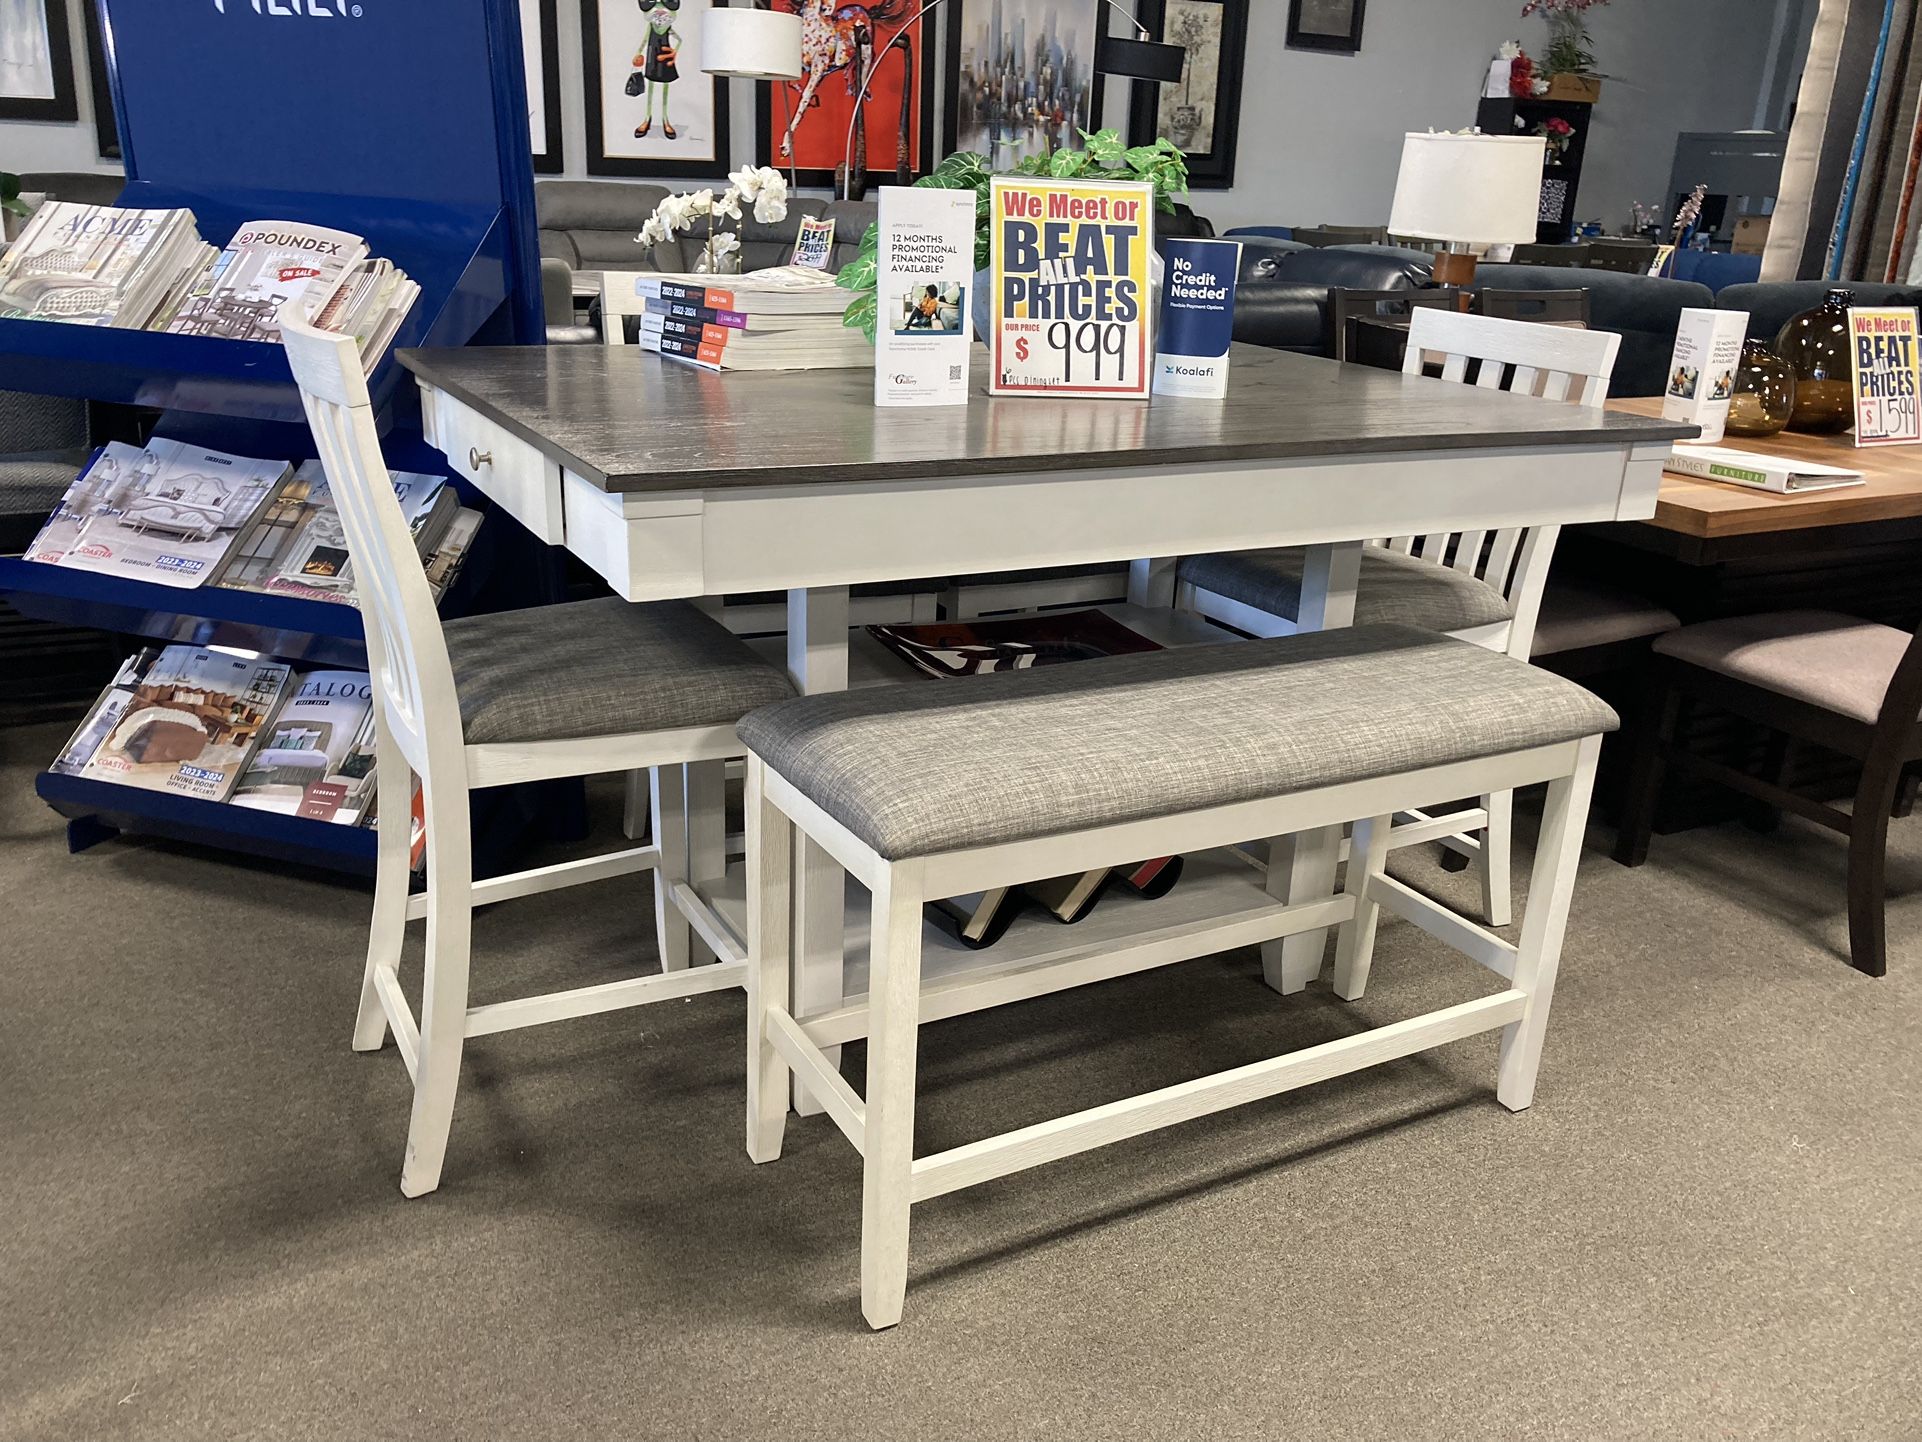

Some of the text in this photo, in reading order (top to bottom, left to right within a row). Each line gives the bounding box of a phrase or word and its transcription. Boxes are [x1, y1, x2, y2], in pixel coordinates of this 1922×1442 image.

[1003, 191, 1139, 221] We Meet or
[59, 213, 153, 236] ACME
[801, 229, 832, 242] BEAT
[892, 234, 943, 243] 12 MONTHS
[253, 232, 342, 255] POUNDEX
[798, 242, 829, 253] PRICES
[891, 244, 958, 254] PROMOTIONAL
[1003, 220, 1138, 277] BEAT
[891, 254, 945, 263] FINANCING
[1173, 257, 1192, 271] No
[1038, 257, 1081, 286] ALL
[1172, 272, 1216, 286] Credit
[662, 286, 685, 298] 2022-2024
[1003, 276, 1137, 323] PRICES
[672, 305, 696, 317] 2022-2024
[1186, 303, 1207, 311] Payment
[1005, 323, 1040, 332] OUR PRICE
[1855, 317, 1911, 333] We Meet or
[1015, 336, 1029, 362] $
[1047, 321, 1126, 383] 999
[1857, 335, 1912, 369] BEAT
[1175, 365, 1214, 377] Koalafi
[1859, 370, 1914, 398] PRICES
[1866, 409, 1873, 424] $
[1711, 464, 1765, 483] FURNITURE
[78, 546, 113, 559] COASTER
[120, 557, 198, 576] BEDROOM DINING ROOM
[158, 556, 203, 570] 2023-2024
[97, 758, 133, 772] COASTER
[180, 766, 223, 781] 2023-2024
[166, 781, 216, 796] OFFICE ACCENTS
[169, 774, 216, 789] LIVING ROOM
